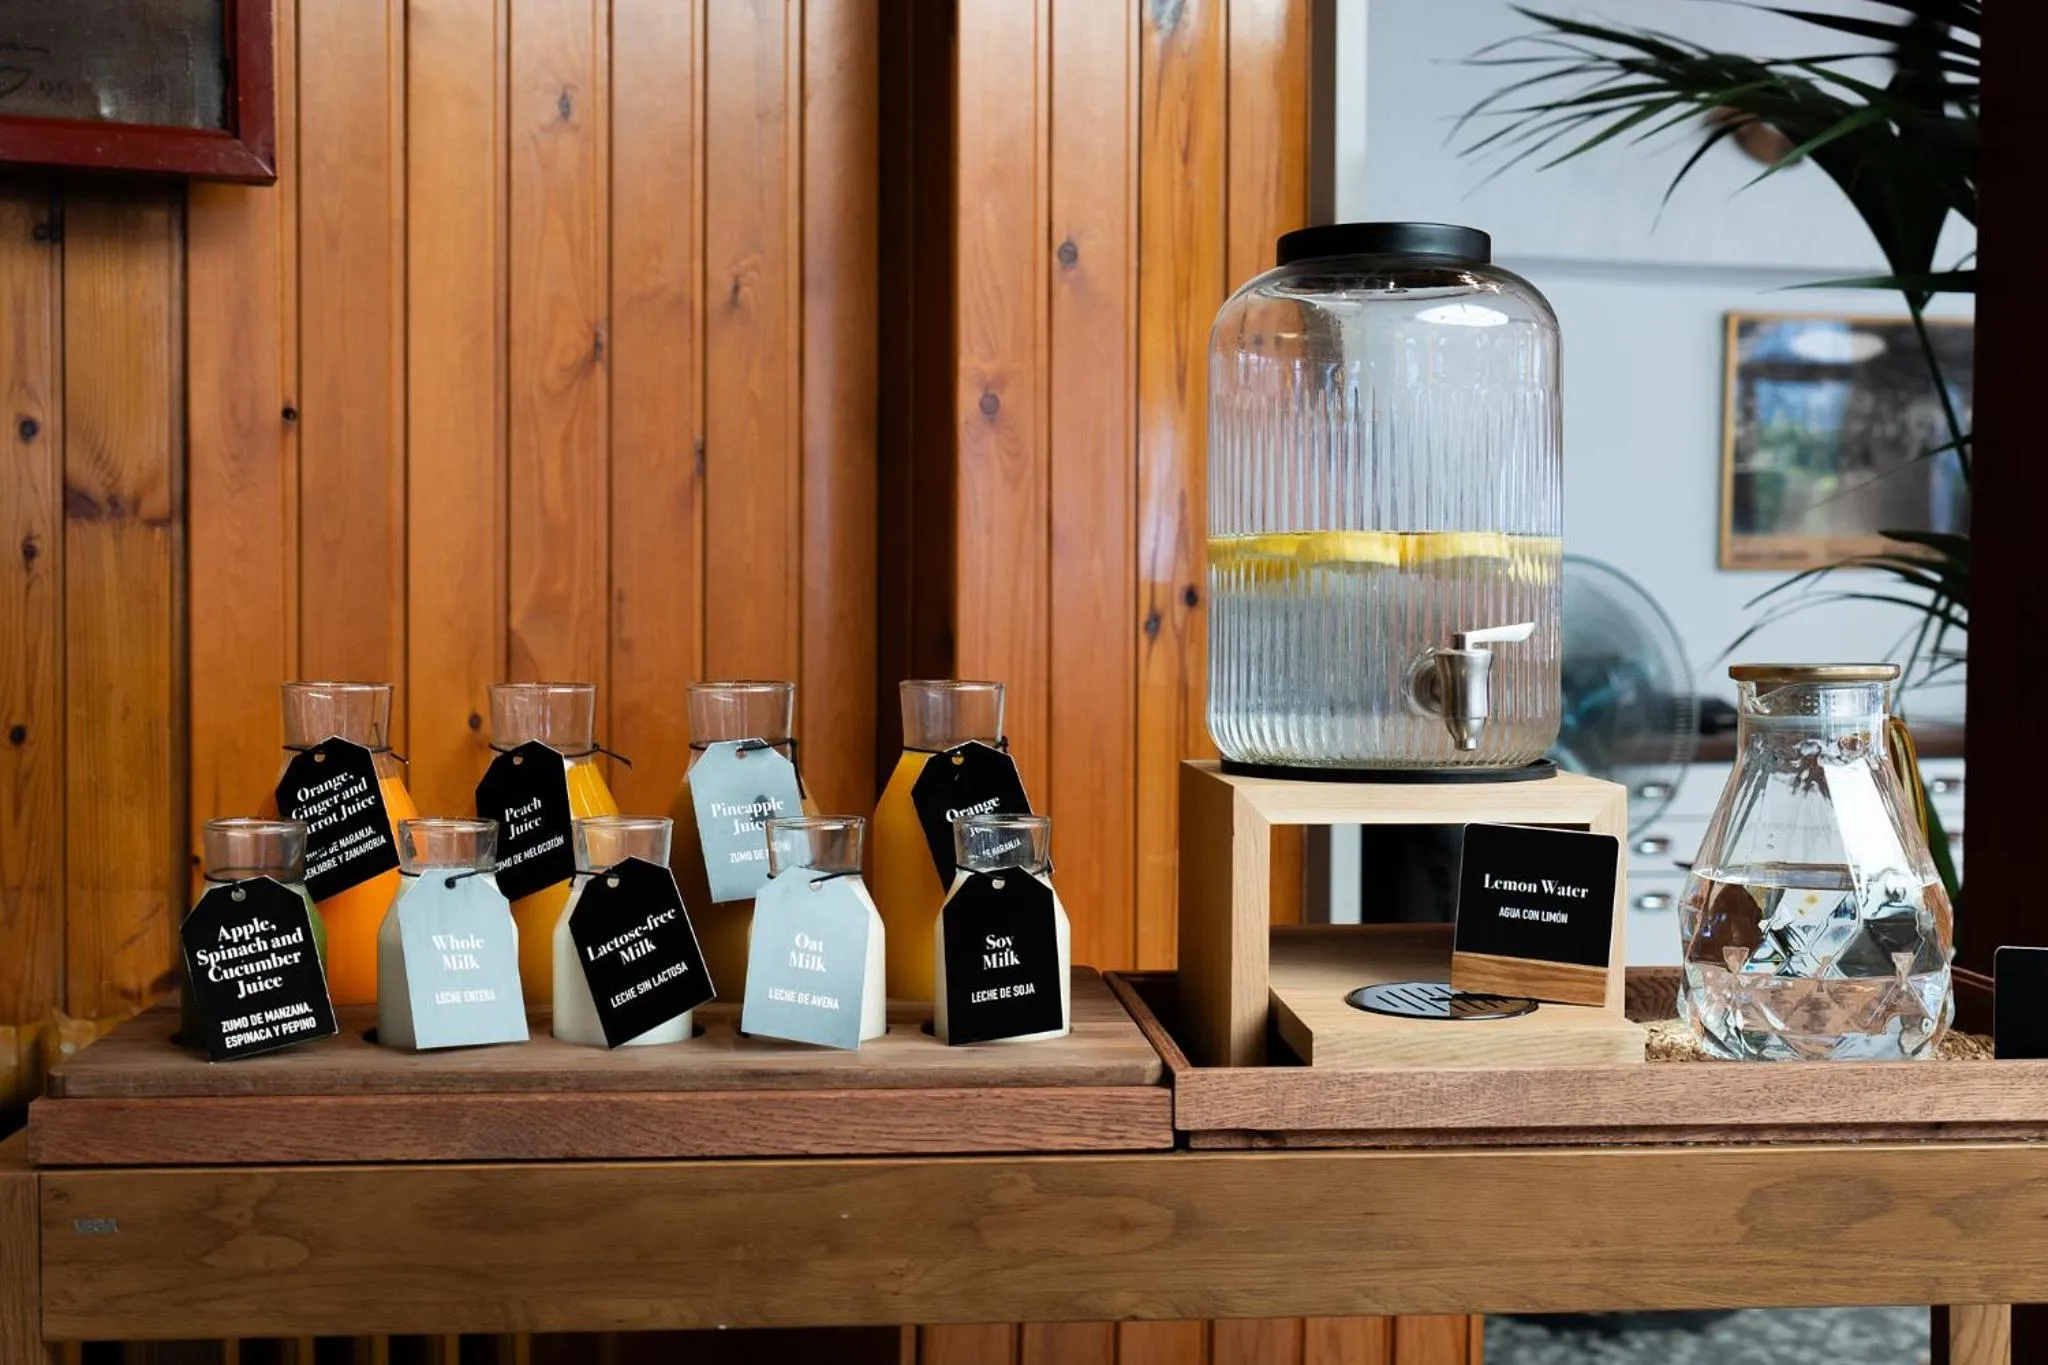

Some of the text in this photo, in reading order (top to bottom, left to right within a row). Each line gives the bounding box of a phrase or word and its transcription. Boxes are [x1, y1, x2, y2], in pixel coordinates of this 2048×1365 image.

[292, 776, 368, 820] Ginger and
[297, 772, 354, 802] Orange,
[306, 794, 376, 835] arrot Juice
[504, 796, 542, 822] Peach
[710, 796, 785, 818] Pineapple
[945, 796, 1001, 823] Orange
[508, 816, 542, 840] Juice
[344, 834, 387, 861] ZANAHORIA
[513, 852, 523, 865] DE
[729, 851, 753, 864] ZUMO
[753, 848, 765, 860] DE
[1483, 873, 1589, 899] Lemon Water
[1498, 906, 1569, 924] AGUA CON LIMÓN
[217, 917, 277, 943] Apple,
[432, 933, 486, 951] Whole
[586, 908, 677, 961] Lactose-free
[196, 926, 304, 968] Spinach and
[618, 937, 657, 966] Milk
[794, 932, 824, 953] Oat
[985, 934, 1014, 952] Soy
[208, 951, 302, 983] Cucumber
[442, 953, 480, 971] Milk
[788, 950, 827, 973] Milk
[983, 950, 1021, 970] Milk
[237, 975, 283, 999] Juice
[435, 988, 497, 1005] LECHE ENTERA
[610, 960, 689, 1009] LECHE SIN LACTOSA
[971, 982, 1036, 1004] LECHE DE SOJA
[768, 986, 840, 1010] LECHE DE AVENA
[221, 1016, 249, 1033] ZUMO
[249, 1012, 263, 1025] DE
[225, 1016, 317, 1049] ESPINACA Y PEPINO
